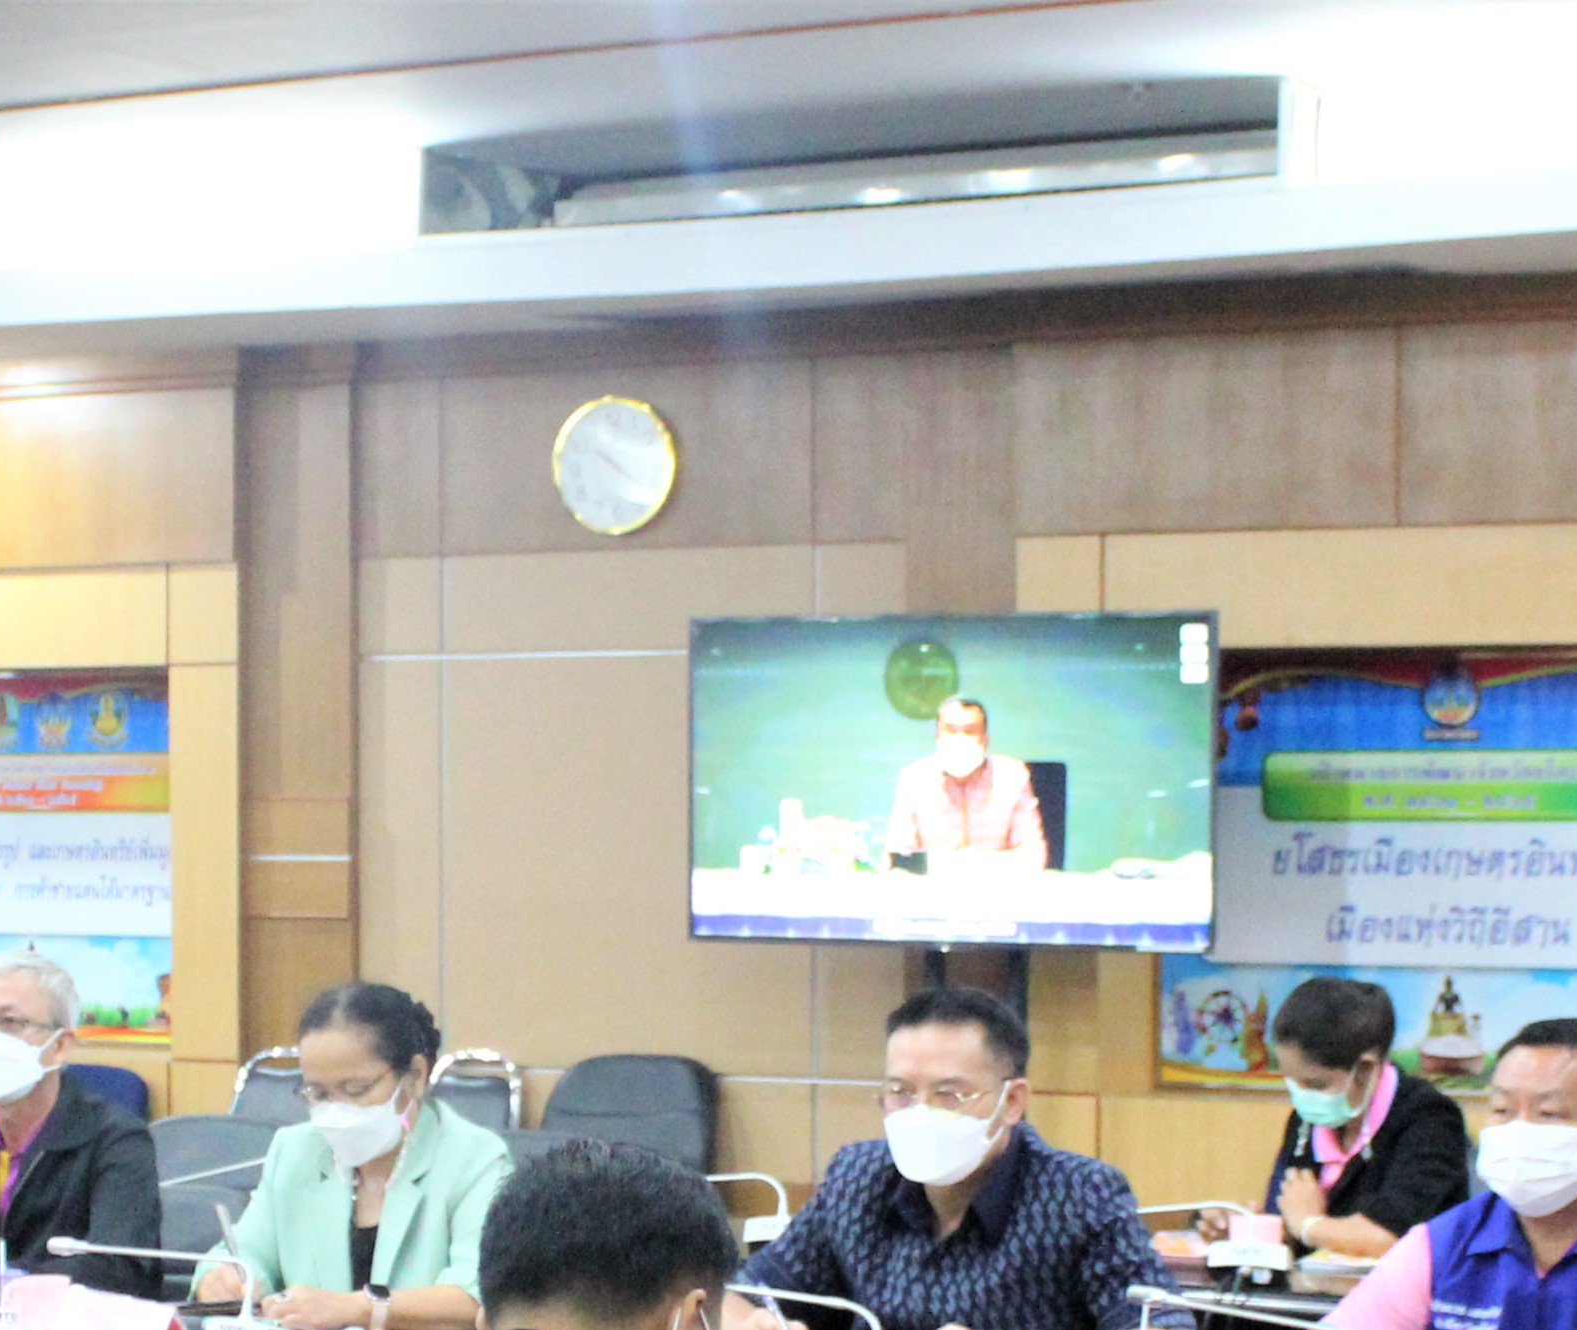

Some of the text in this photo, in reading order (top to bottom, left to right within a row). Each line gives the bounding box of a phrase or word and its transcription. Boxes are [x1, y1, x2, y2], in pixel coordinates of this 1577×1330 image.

[1324, 903, 1573, 949] เมืองแห่งวิถีอีสาน
